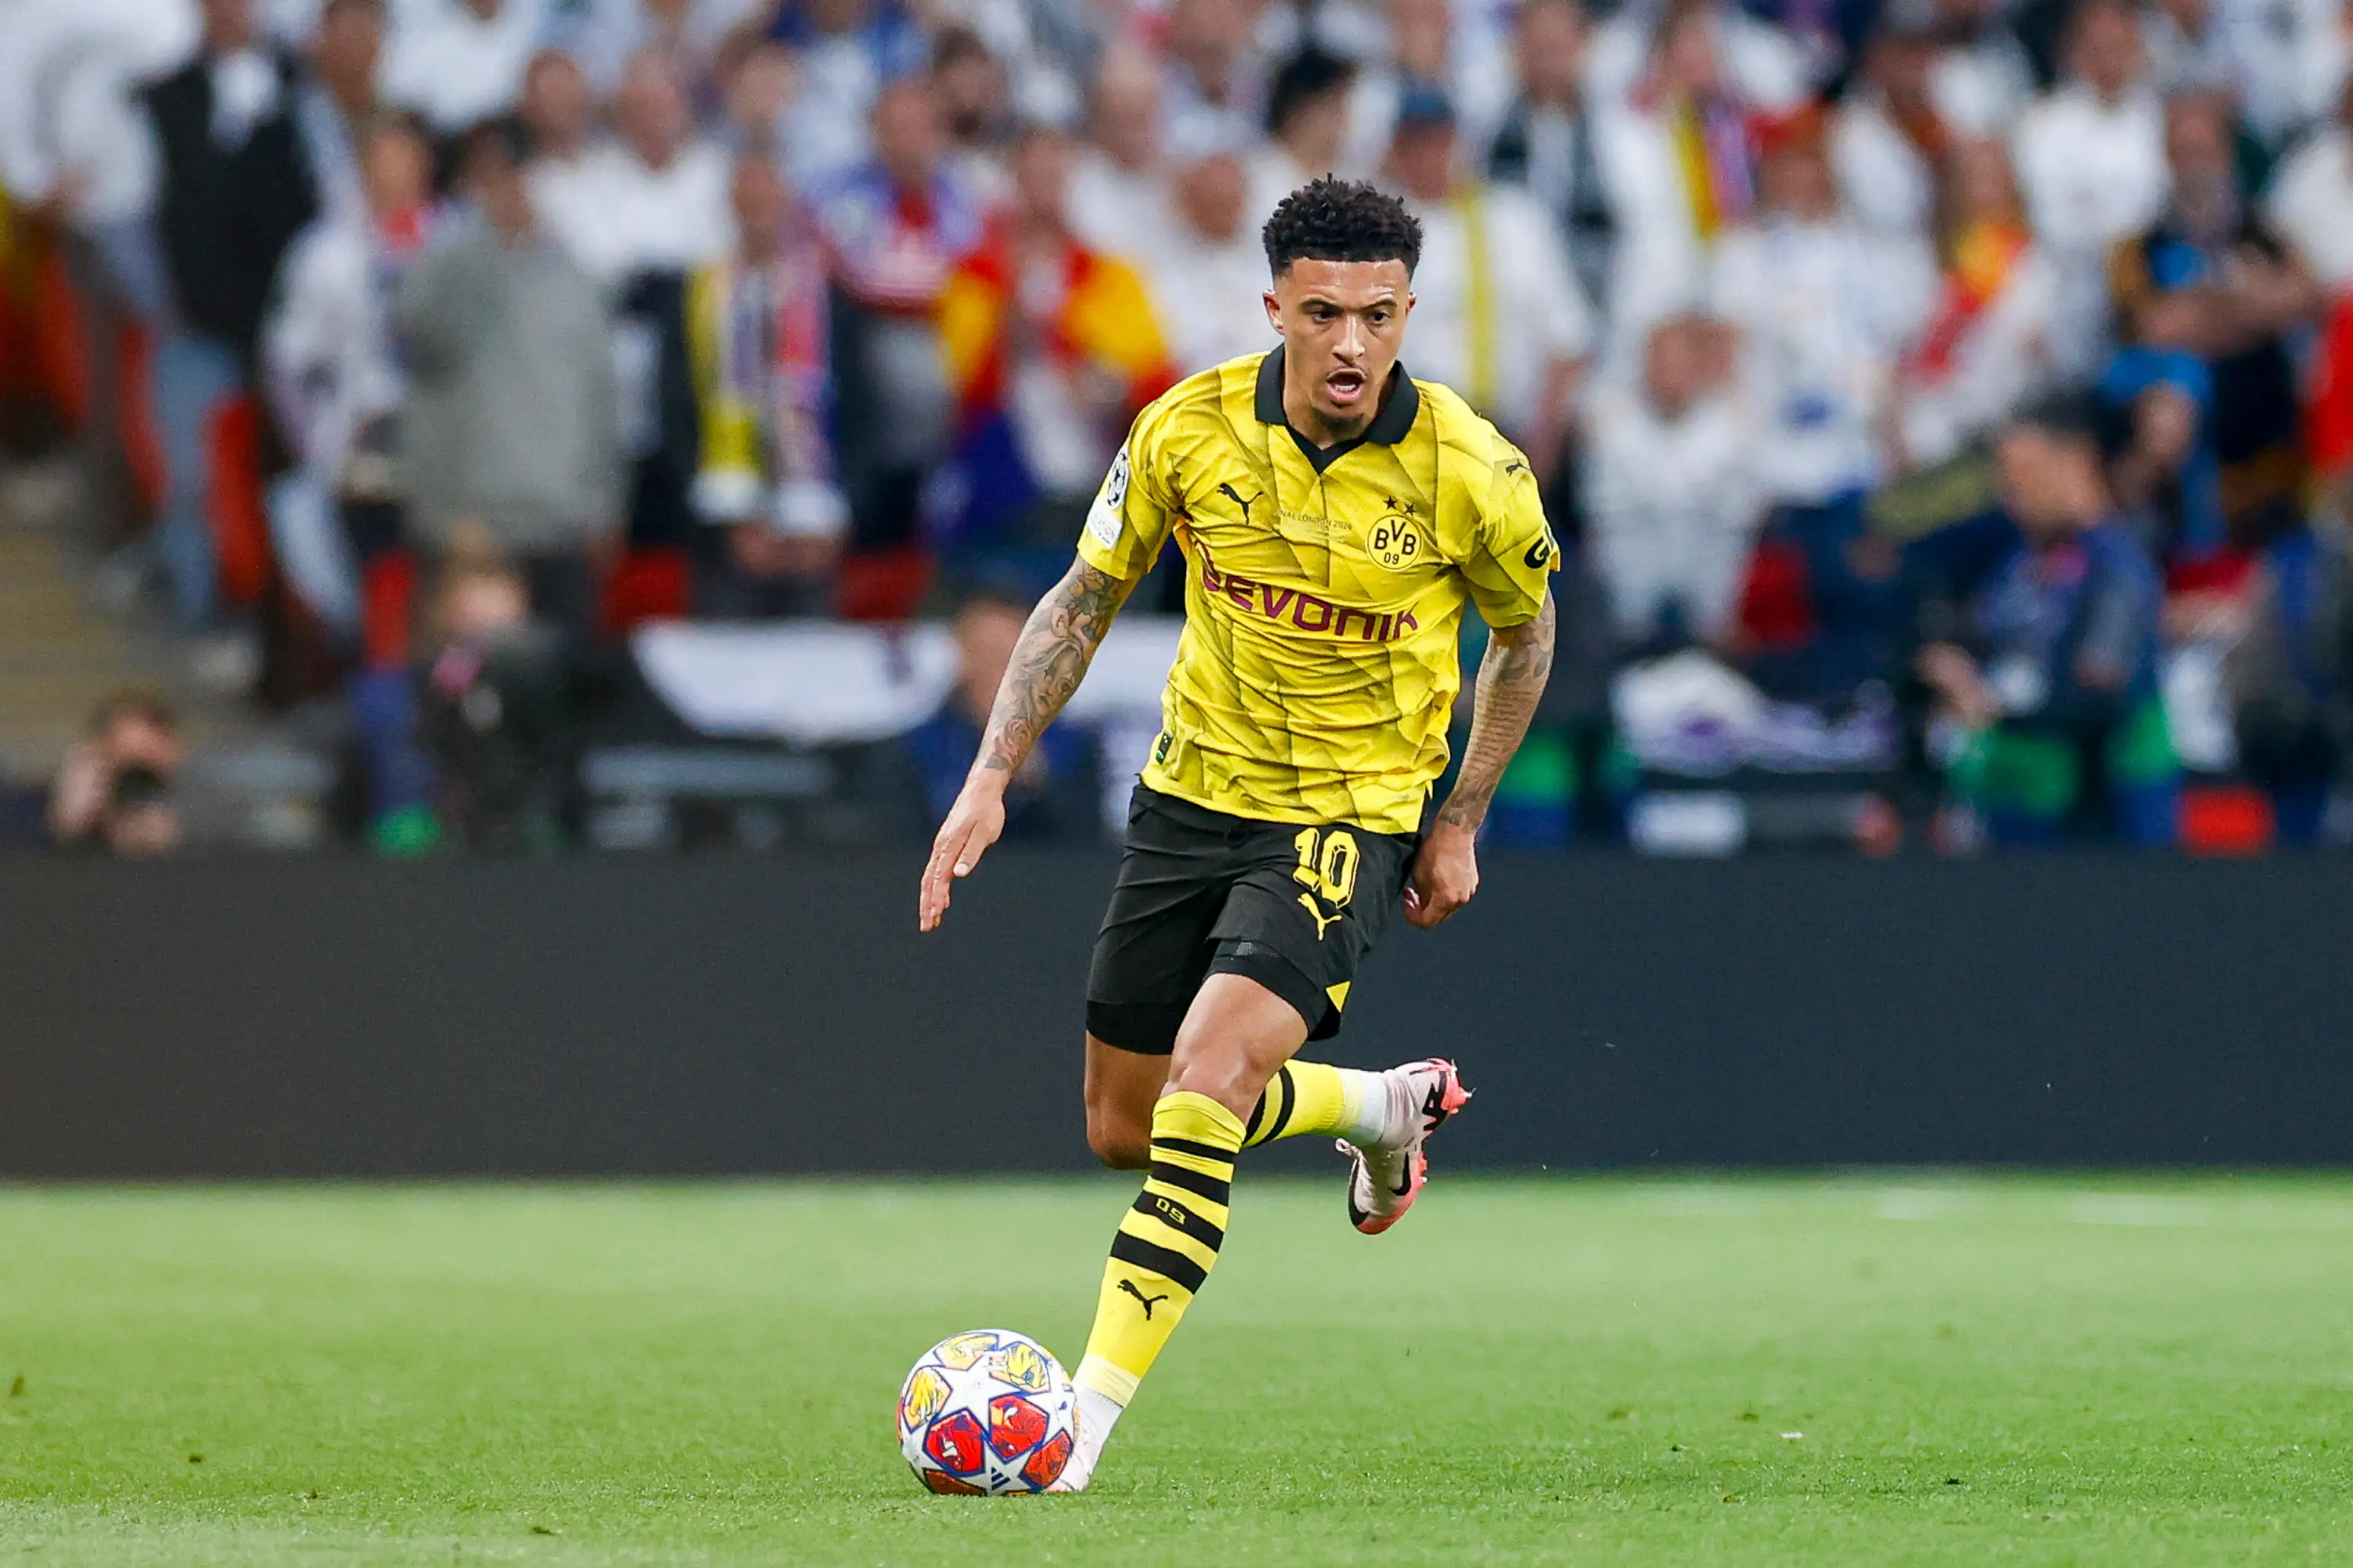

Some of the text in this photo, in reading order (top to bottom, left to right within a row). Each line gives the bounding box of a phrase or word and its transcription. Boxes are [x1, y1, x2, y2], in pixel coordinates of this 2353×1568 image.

[1375, 519, 1417, 556] BVB
[1384, 552, 1400, 565] 09
[1292, 827, 1360, 910] 10
[1156, 1198, 1186, 1225] 09
